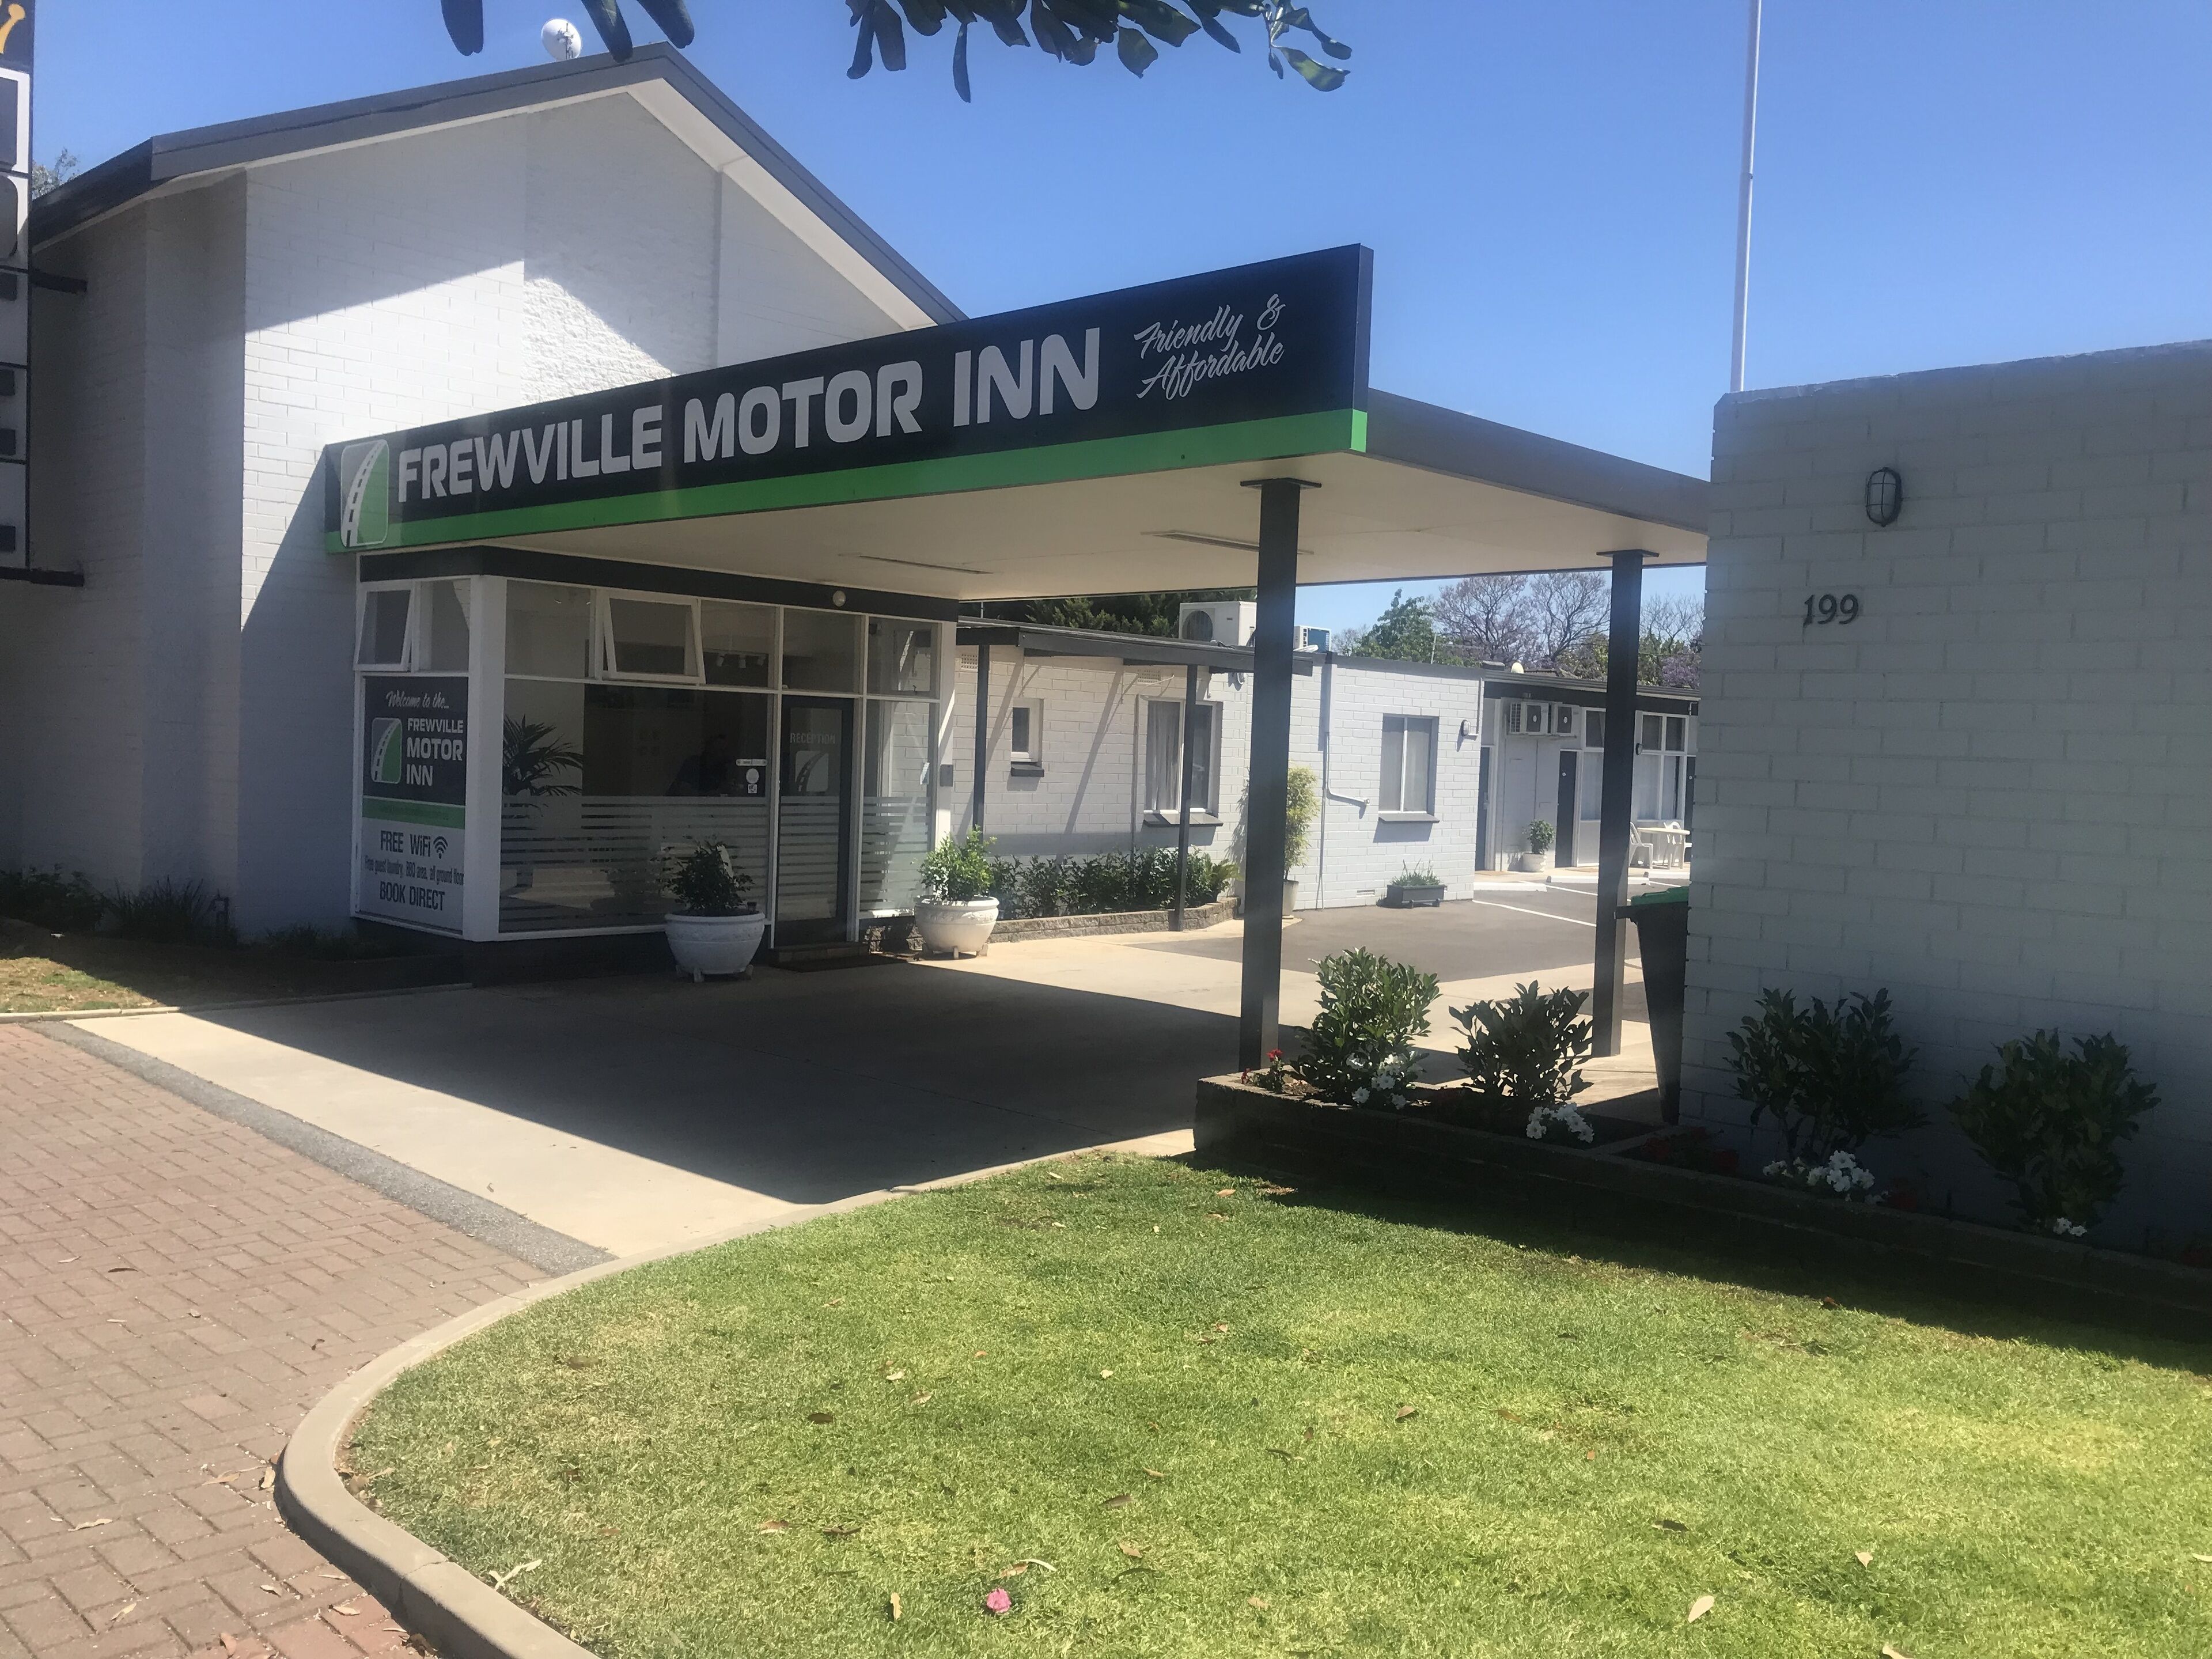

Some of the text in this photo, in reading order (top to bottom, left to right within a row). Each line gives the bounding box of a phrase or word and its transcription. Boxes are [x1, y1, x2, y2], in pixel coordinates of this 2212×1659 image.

[1134, 293, 1286, 359] Friendly &
[1137, 332, 1285, 400] Affordable
[399, 327, 1100, 502] FREWVILLE MOTOR INN
[1803, 594, 1858, 627] 199
[386, 690, 420, 709] Welcome
[422, 692, 430, 709] to
[407, 718, 463, 733] FREWVILLE
[790, 732, 836, 744] RECEPTION
[407, 737, 463, 761] MOTOR
[406, 764, 433, 786] INN
[380, 830, 431, 857] FREE WiFi
[436, 868, 452, 885] ground
[380, 881, 445, 911] BOOK DIRECT
